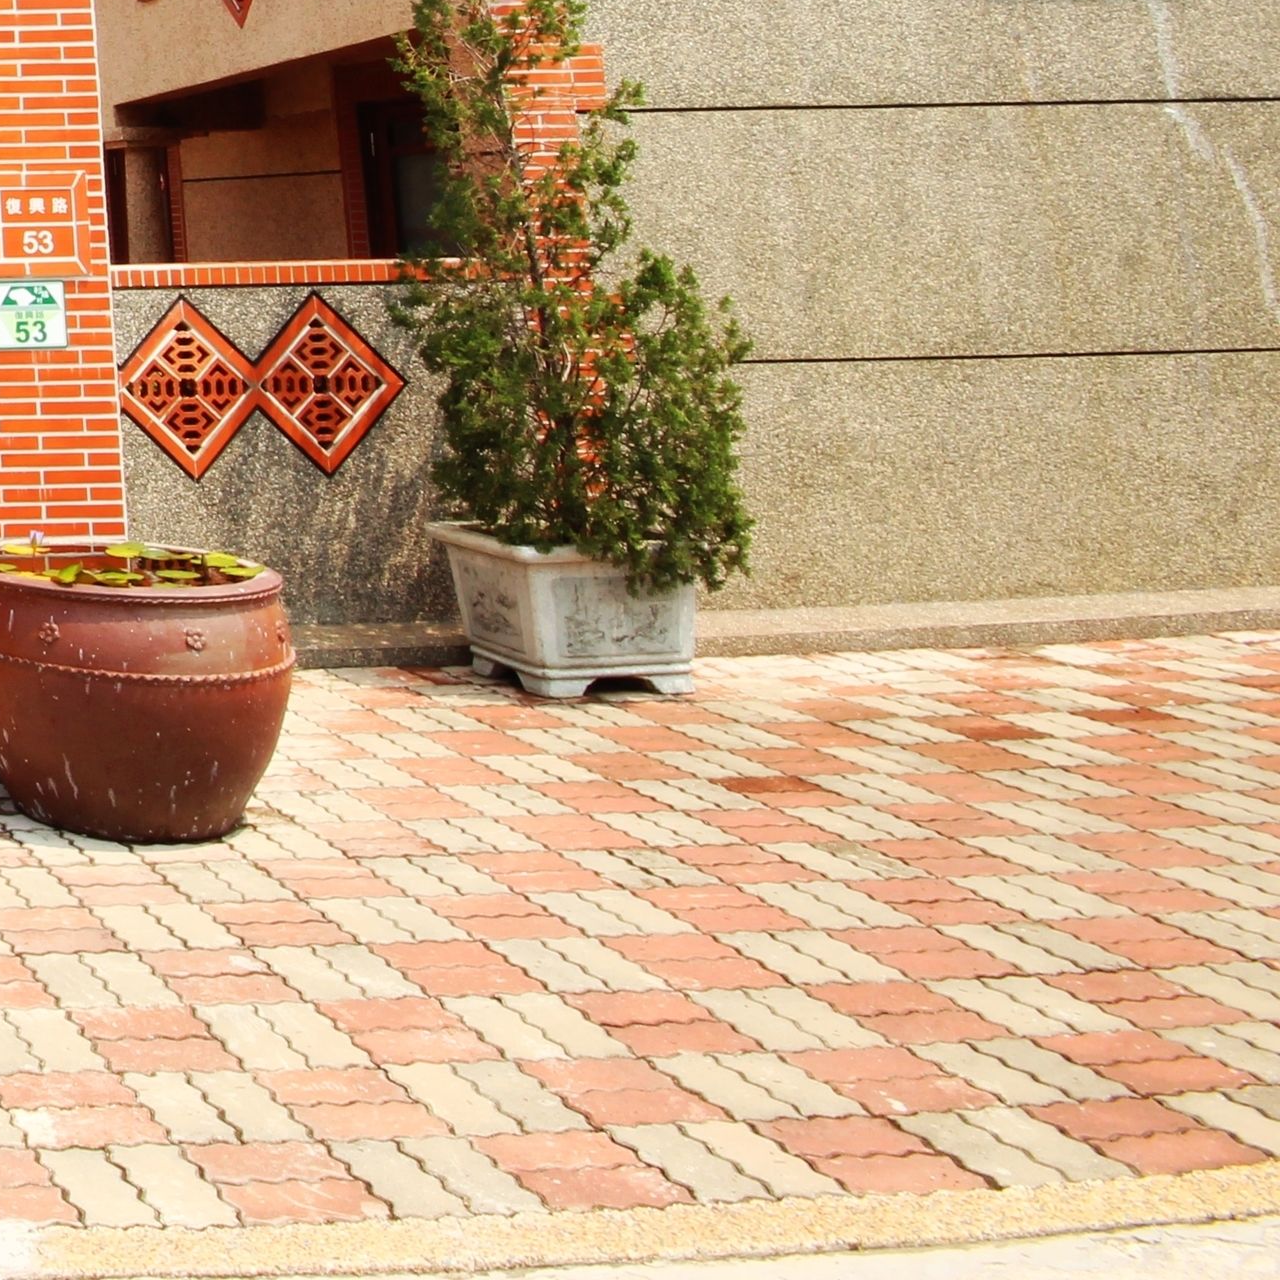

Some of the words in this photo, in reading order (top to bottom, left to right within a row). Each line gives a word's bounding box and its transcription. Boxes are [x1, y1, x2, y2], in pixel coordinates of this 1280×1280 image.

[5, 197, 68, 216] 復興路
[22, 230, 55, 255] 53
[15, 320, 48, 343] 53
